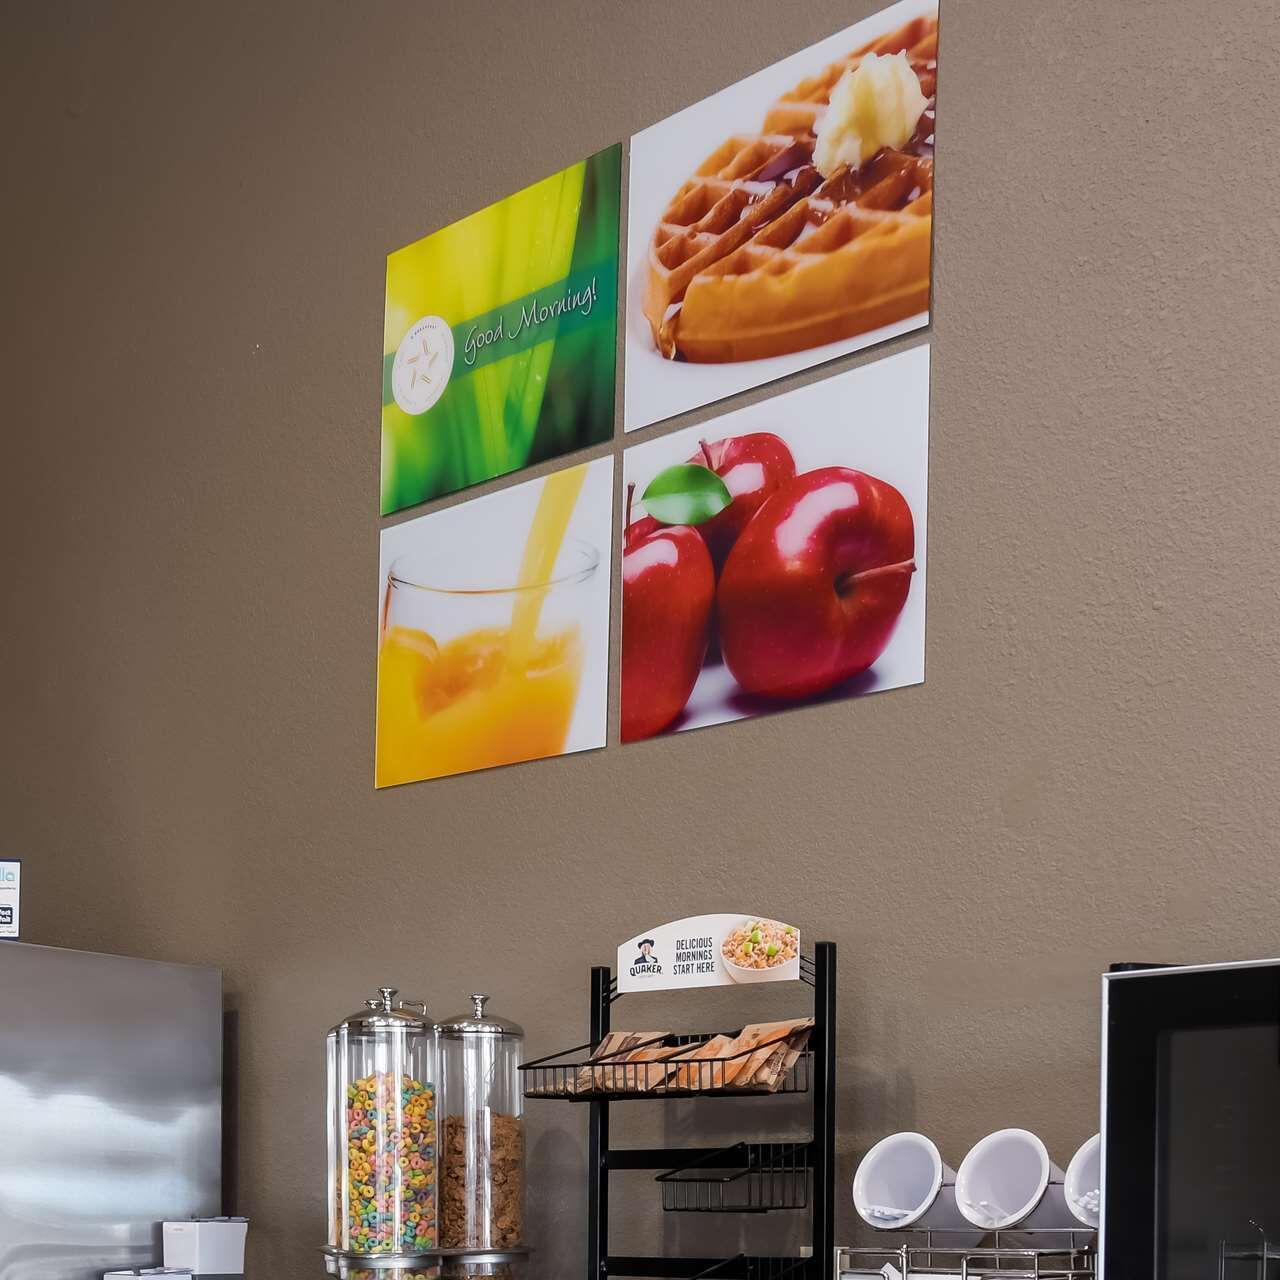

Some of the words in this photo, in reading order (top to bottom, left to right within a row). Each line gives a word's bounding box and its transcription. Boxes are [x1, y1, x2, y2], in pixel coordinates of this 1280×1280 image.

[464, 315, 504, 365] Good
[508, 276, 597, 340] Morning!
[675, 937, 713, 951] DELICIOUS
[675, 950, 713, 963] MORNINGS
[629, 963, 662, 977] QUAKER
[673, 963, 694, 975] START
[696, 961, 715, 974] HERE
